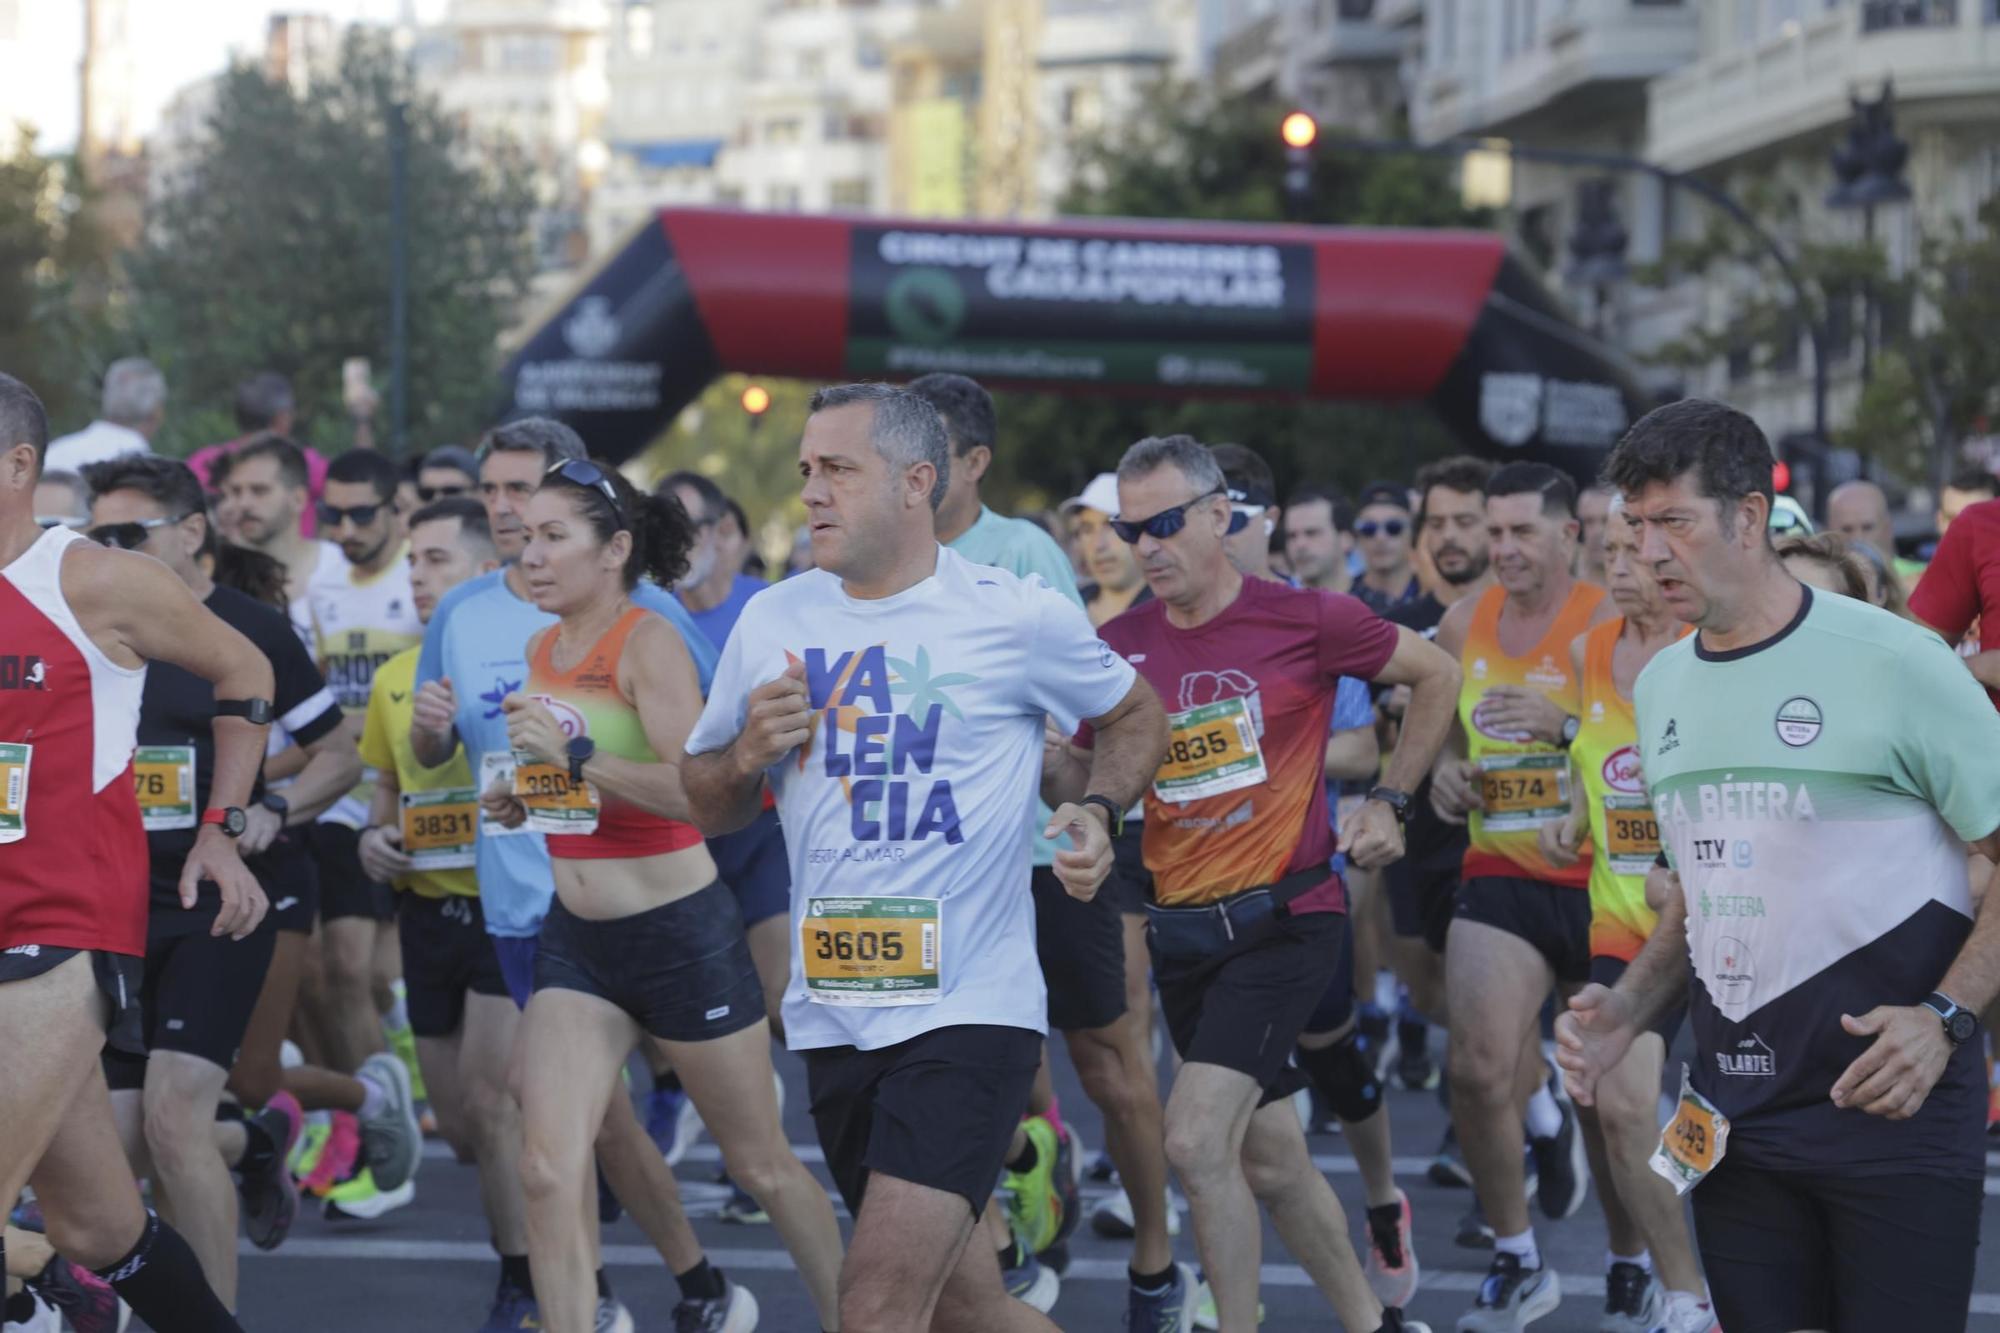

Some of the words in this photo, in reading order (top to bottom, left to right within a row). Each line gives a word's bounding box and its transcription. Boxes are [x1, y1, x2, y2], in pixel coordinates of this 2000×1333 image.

[805, 646, 892, 713] VA
[825, 704, 943, 777] LEN
[852, 780, 964, 845] CIA
[1488, 778, 1545, 800] 3574
[1698, 773, 1817, 821] BÉTERA
[414, 813, 471, 836] 3831
[815, 930, 904, 961] 3605
